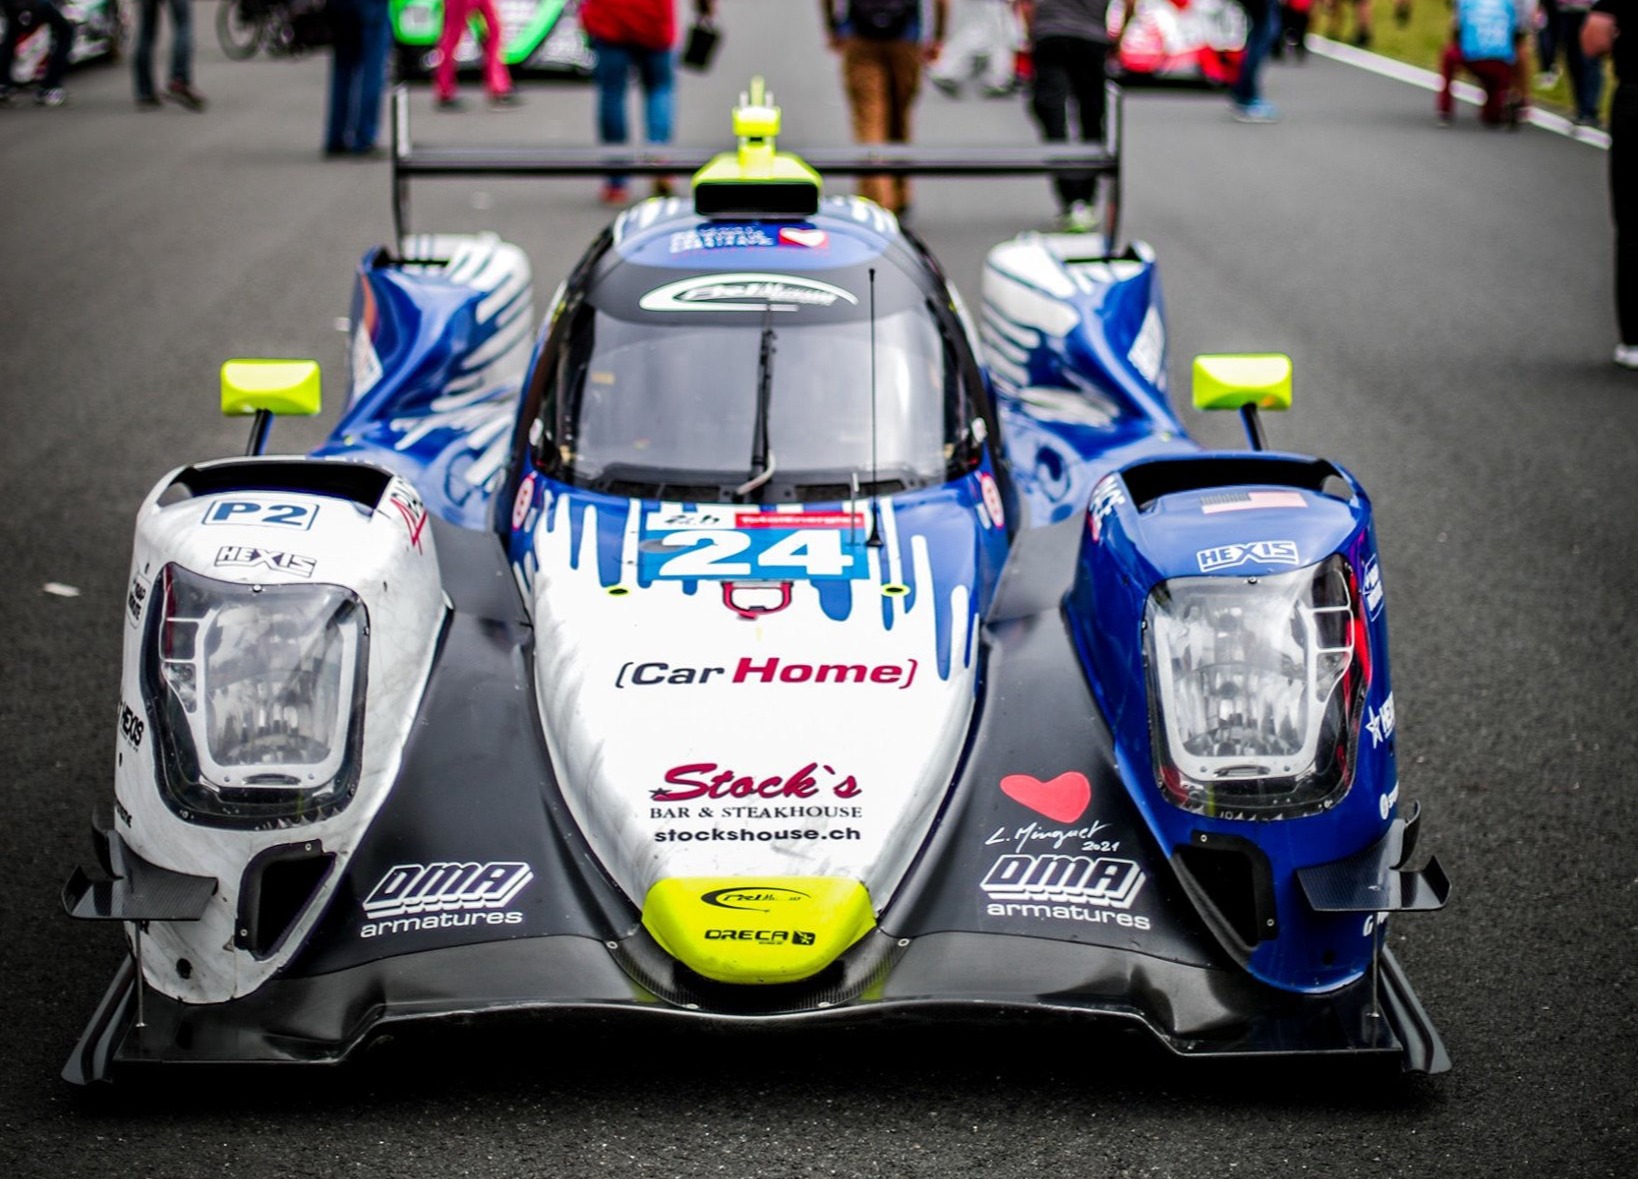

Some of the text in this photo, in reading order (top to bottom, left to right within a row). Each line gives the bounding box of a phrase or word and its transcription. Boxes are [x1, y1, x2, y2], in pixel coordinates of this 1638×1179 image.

[212, 502, 308, 526] P2
[214, 546, 317, 578] HEXIS
[659, 529, 854, 576] 24
[1196, 540, 1299, 573] HEXIS
[650, 806, 862, 819] BAR & STEAKHOUSE
[654, 827, 861, 842] stockshouse.ch
[360, 911, 523, 938] armatures
[987, 903, 1151, 930] armatures
[704, 929, 789, 941] ORECA
